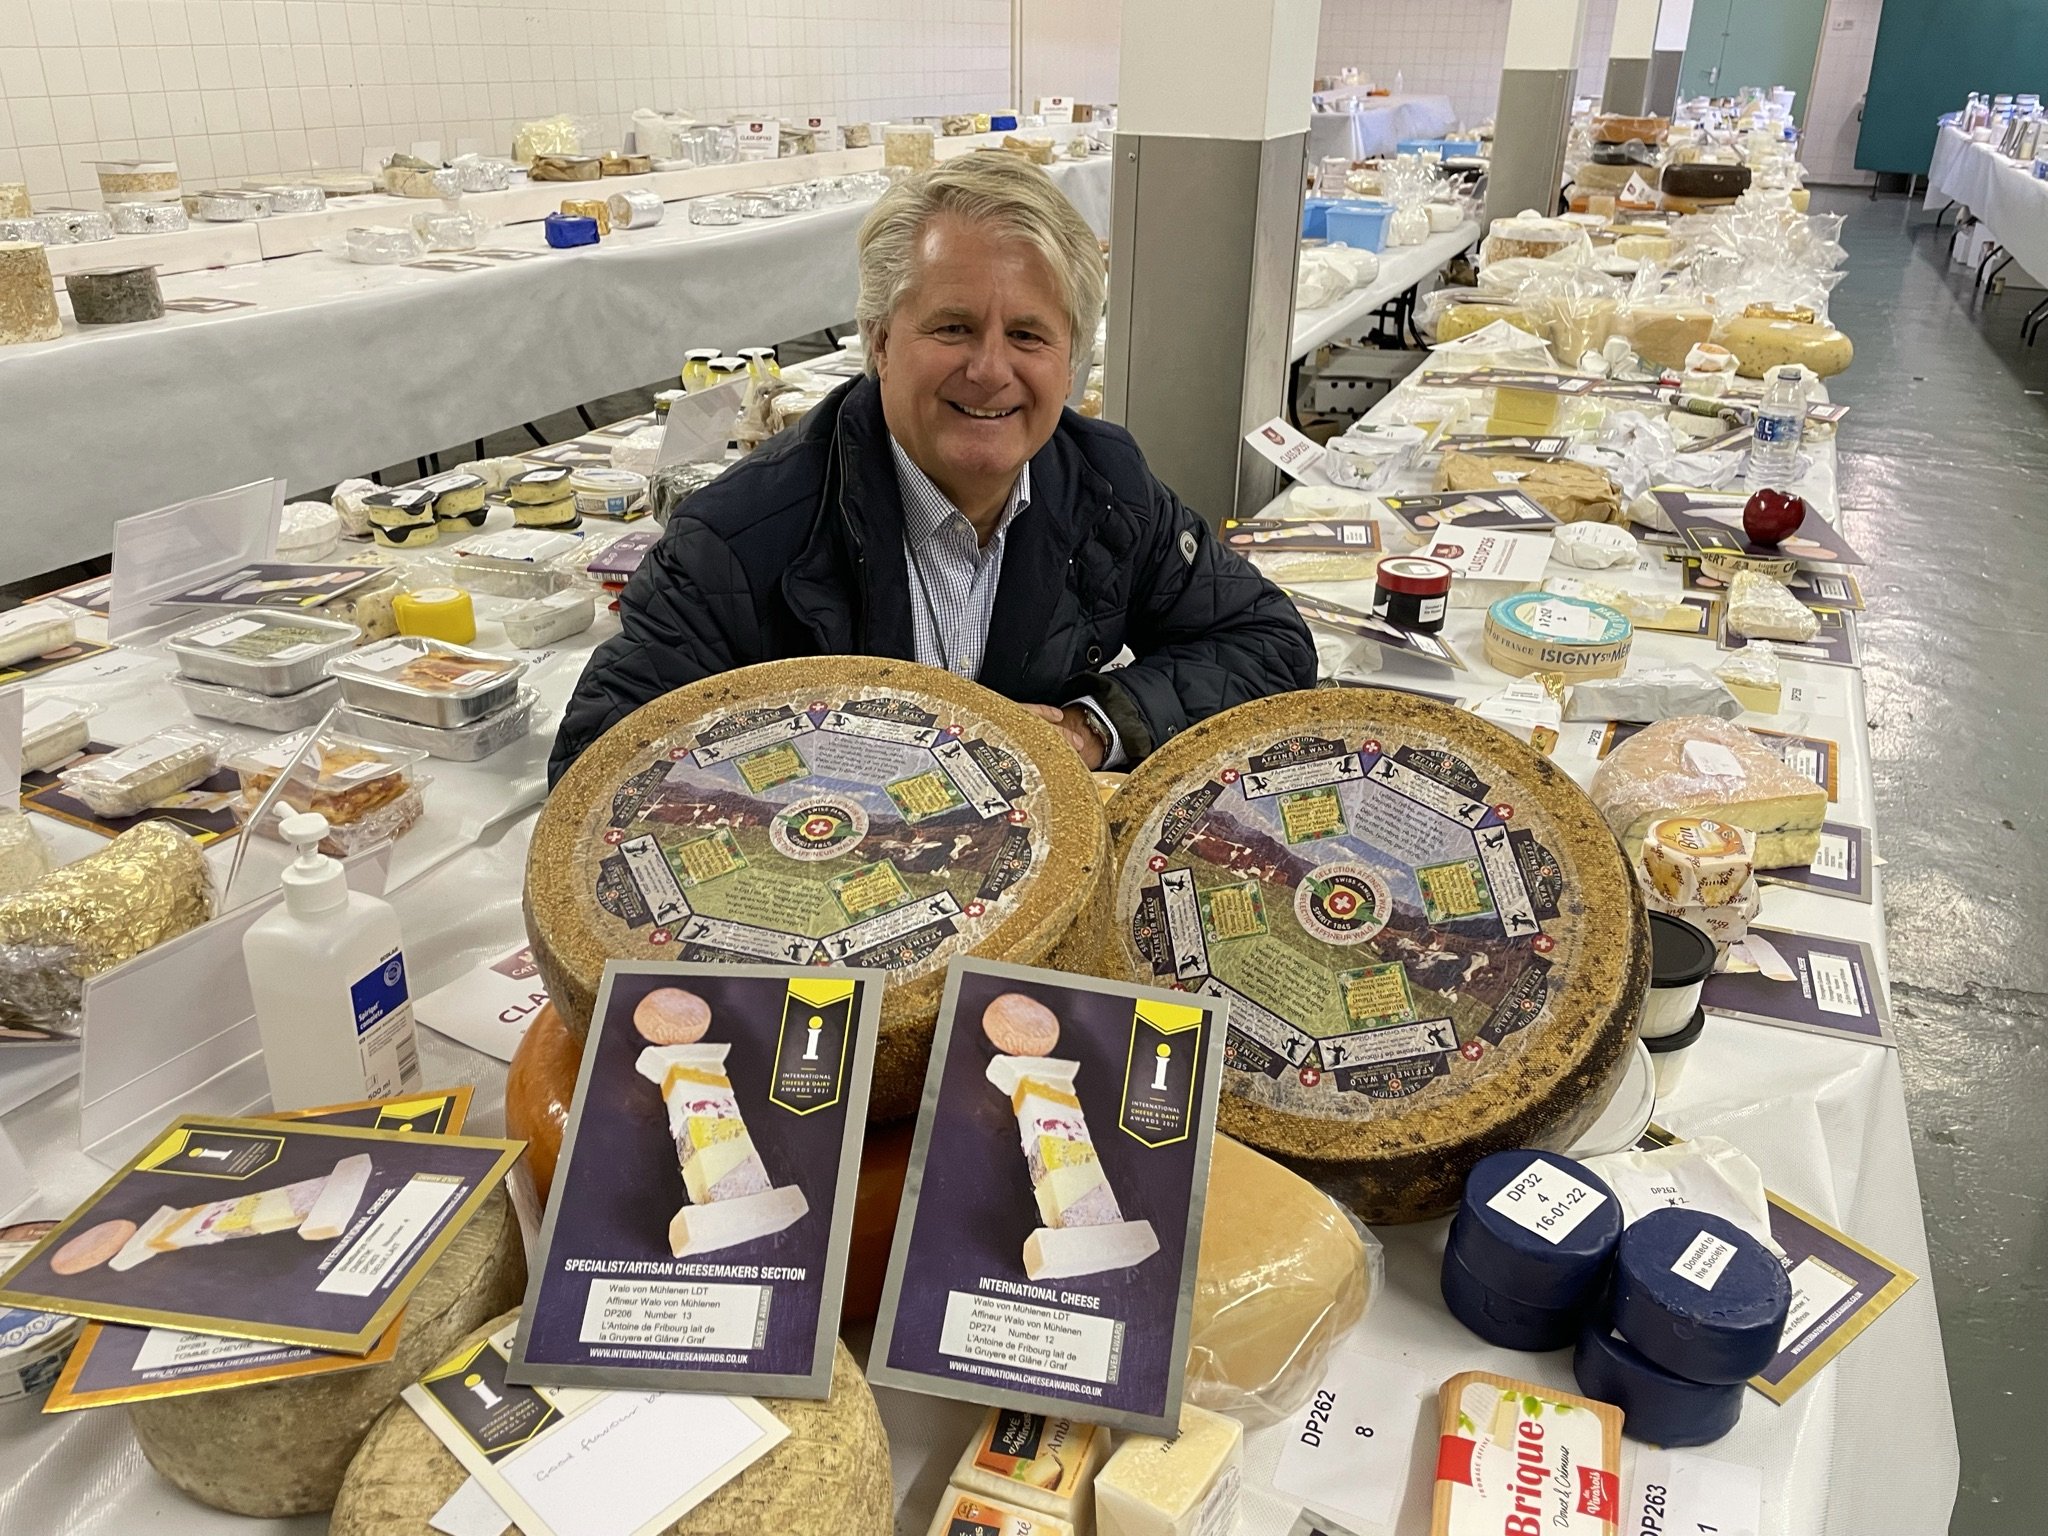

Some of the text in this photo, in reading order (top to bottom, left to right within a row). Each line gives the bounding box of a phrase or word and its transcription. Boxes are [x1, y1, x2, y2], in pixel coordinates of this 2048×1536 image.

[1540, 648, 1601, 665] ISIGNY
[1261, 744, 1334, 763] AFFINEUR WALO
[1274, 736, 1314, 750] SELECTION
[1409, 753, 1478, 789] AFFINEUR WALO
[1430, 751, 1470, 772] SELECTION
[1164, 795, 1191, 828] SELECTION
[1165, 789, 1211, 845] AFFINEUR WALO
[1678, 826, 1699, 850] Brin
[1315, 866, 1386, 899] SELECTION AFFINEUR
[1523, 841, 1552, 908] AFFINEUR WALO
[1542, 851, 1562, 890] SELECTION
[1357, 881, 1373, 901] FAMILY
[1299, 893, 1374, 940] SELECTION AFFINEUR WALO
[1313, 906, 1332, 926] SPIRIT
[1135, 912, 1148, 952] SELECTION
[1146, 919, 1164, 963] AFFINEUR
[499, 986, 549, 1024] CLA
[1494, 968, 1542, 1034] AFFINEUR WALO
[1517, 989, 1546, 1027] SELECTION
[360, 1008, 383, 1030] complete
[1350, 1065, 1435, 1086] AFFINEUR WALO
[1371, 1081, 1421, 1098] SELECTION
[1131, 1108, 1153, 1116] CHEESE
[1132, 1101, 1180, 1113] INTERNATIONAL
[1130, 1116, 1159, 1125] AWARDS
[1507, 1173, 1542, 1202] DP32
[1537, 1193, 1549, 1203] 4
[1536, 1187, 1586, 1231] 16-01-22
[1683, 1237, 1714, 1270] Donated to
[1695, 1245, 1728, 1279] the Society
[565, 1259, 806, 1281] SPECIALIST/ARTISAN CHEESEMAKERS SECTION
[606, 1297, 638, 1306] Affineur
[640, 1298, 662, 1307] Walo
[609, 1285, 631, 1294] Walo
[691, 1287, 709, 1296] LDT
[979, 1277, 1100, 1310] INTERNATIONAL CHEESE
[604, 1309, 692, 1320] DP206 Number 13
[971, 1309, 1001, 1322] Affineur
[1004, 1315, 1025, 1326] Walo
[1027, 1321, 1041, 1329] von
[973, 1297, 994, 1308] Walo
[996, 1303, 1011, 1311] von
[1053, 1310, 1070, 1321] LDT
[601, 1322, 715, 1334] L'Antoine de Fribourg lait de
[644, 1334, 652, 1342] et
[686, 1335, 706, 1344] Graf
[969, 1322, 1055, 1344] DP274 Number 12
[590, 1348, 748, 1364] WWW.INTERNATIONALCHEESEAWARDS.CO.UK
[965, 1345, 972, 1353] la
[1008, 1353, 1016, 1362] et
[1049, 1360, 1068, 1371] Graf
[967, 1334, 1077, 1361] L'Antoine de Fribourg lait de
[949, 1361, 1102, 1397] WWW.INTERNATIONALCHEESEAWARDS.CO.UK
[1107, 1354, 1119, 1382] SILVER
[1003, 1417, 1020, 1444] PAVÉ
[1301, 1390, 1336, 1448] DP262
[1355, 1426, 1374, 1438] 8
[1505, 1421, 1551, 1536] Brique
[1587, 1472, 1600, 1514] Vivarois
[1553, 1498, 1569, 1528] Douce
[1697, 1522, 1718, 1534] 1
